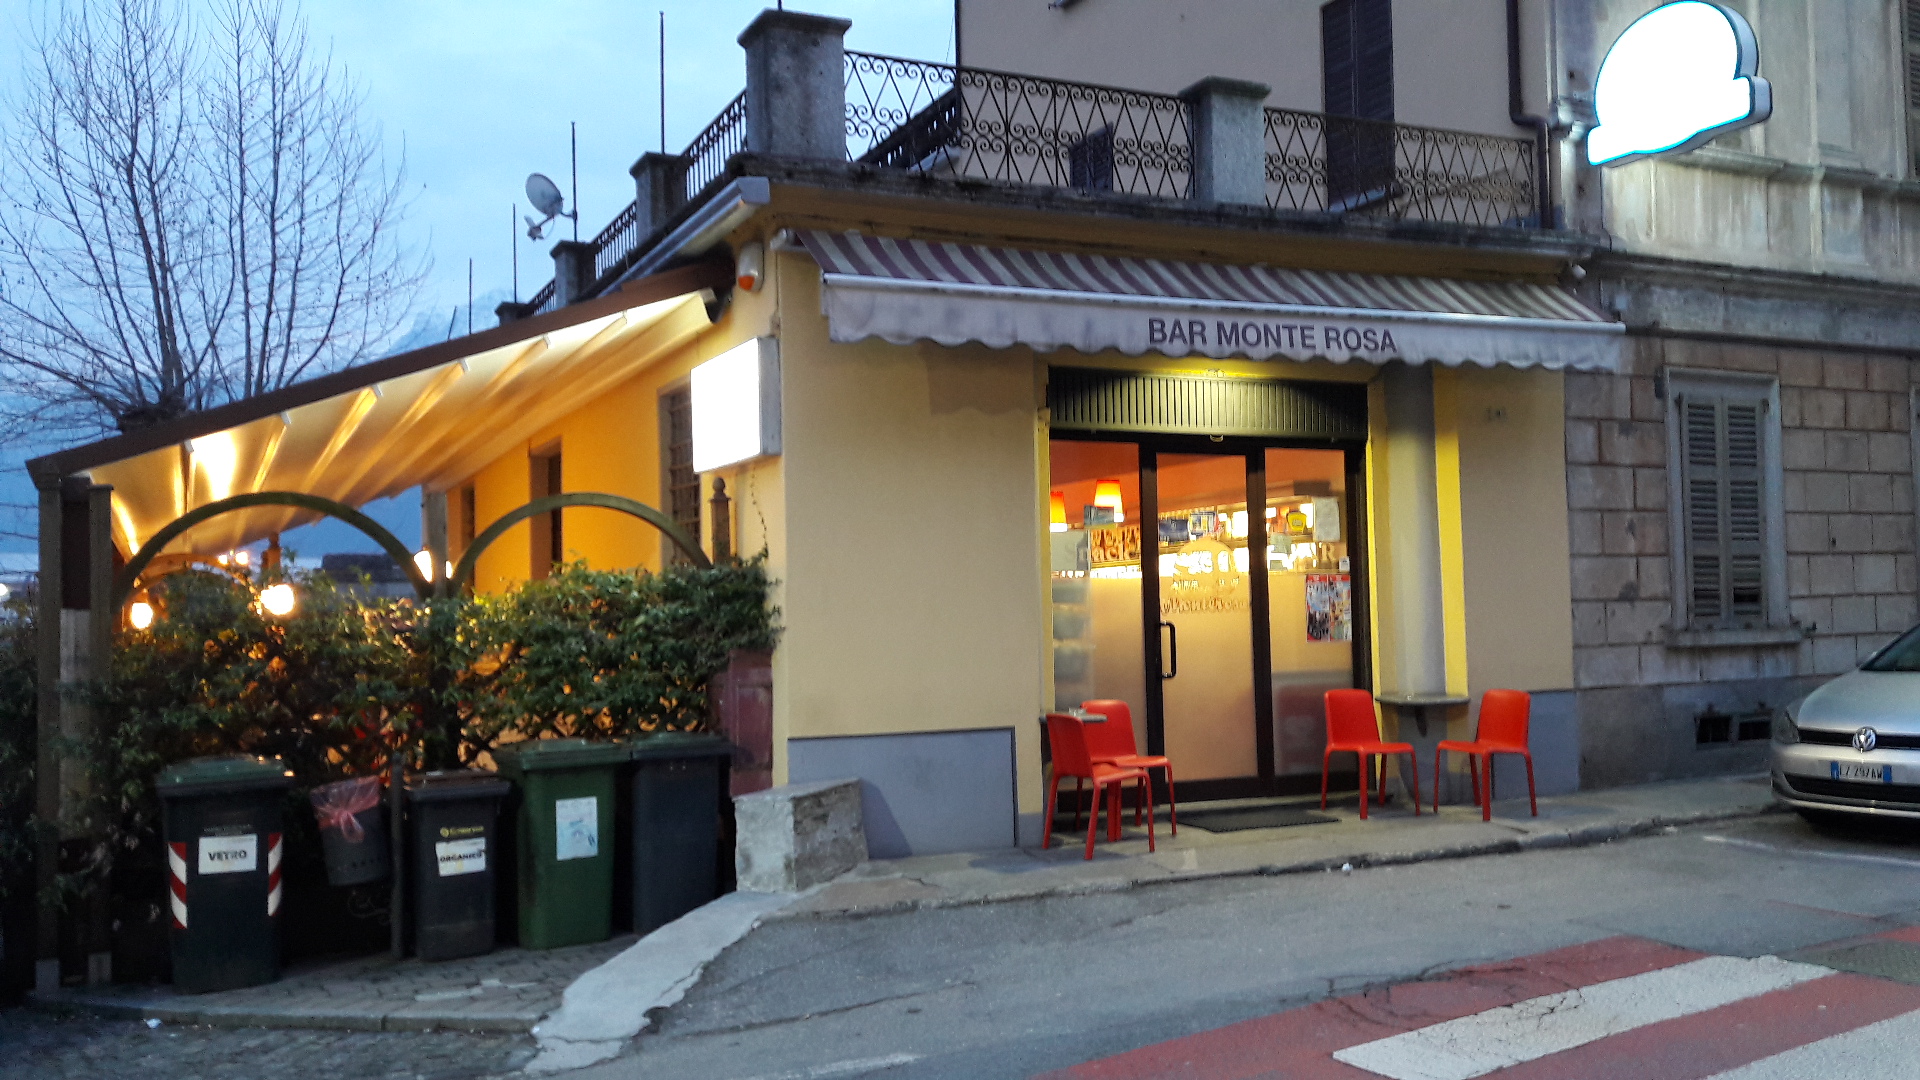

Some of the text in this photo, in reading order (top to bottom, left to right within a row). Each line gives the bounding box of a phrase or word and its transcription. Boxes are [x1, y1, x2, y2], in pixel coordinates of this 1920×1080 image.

[1148, 317, 1397, 353] BAR MONTE ROSA
[208, 850, 247, 861] VETRO
